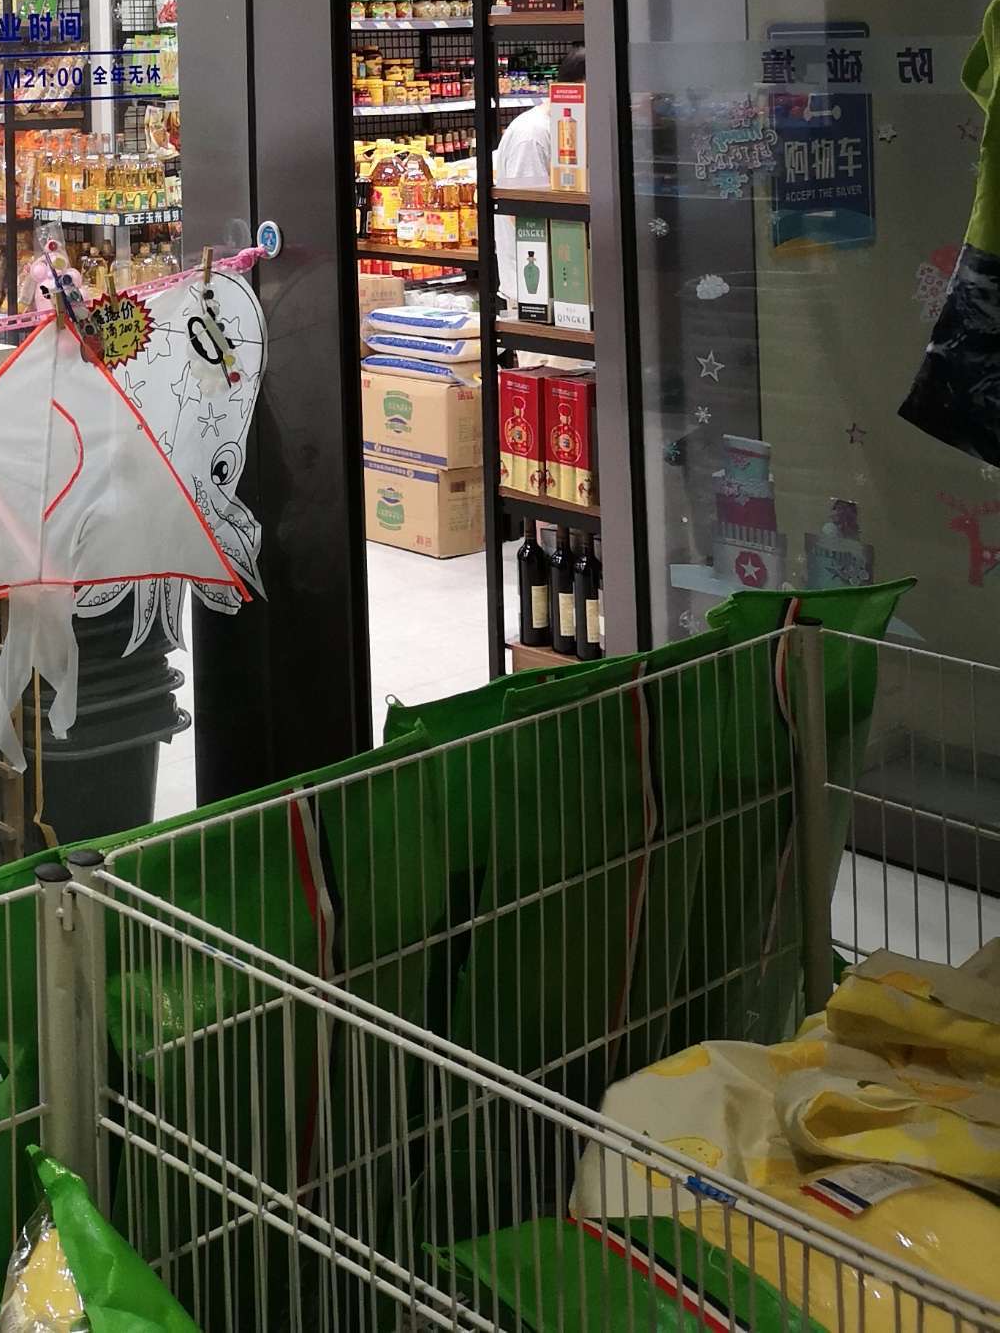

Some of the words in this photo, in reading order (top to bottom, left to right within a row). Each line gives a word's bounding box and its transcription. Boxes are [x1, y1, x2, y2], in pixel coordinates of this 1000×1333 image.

[92, 64, 161, 86] 全年无休
[784, 137, 863, 183] 购物车
